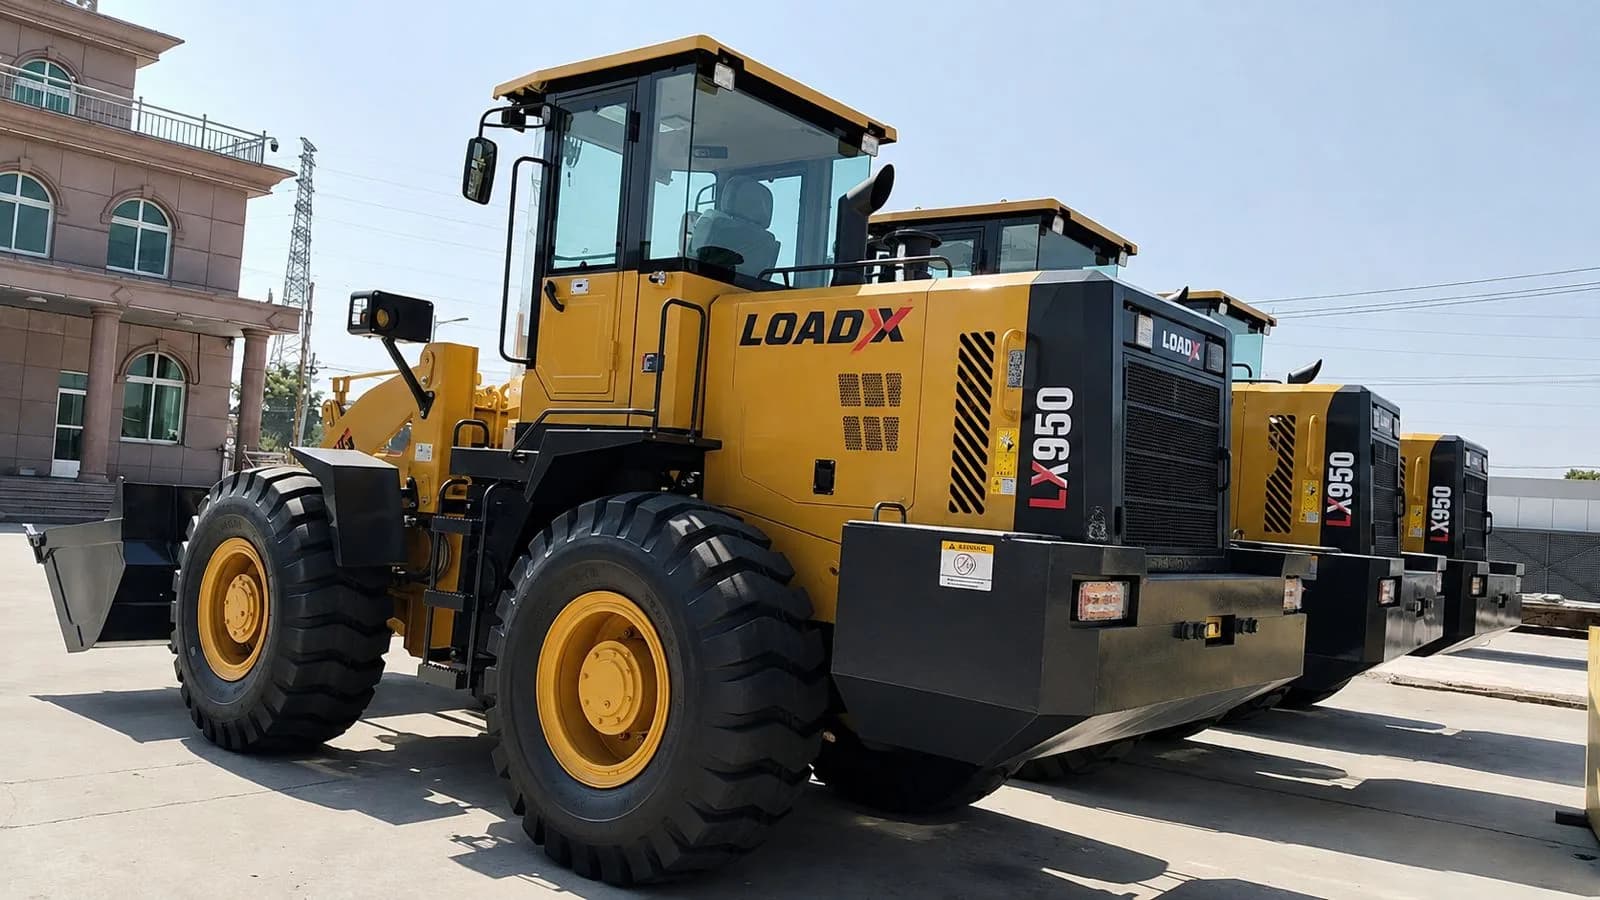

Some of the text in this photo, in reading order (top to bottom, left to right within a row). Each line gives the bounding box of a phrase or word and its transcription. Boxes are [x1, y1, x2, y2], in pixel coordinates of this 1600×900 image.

[739, 307, 914, 351] LOADX
[1162, 330, 1200, 362] LOADX
[1029, 387, 1074, 509] LX950
[1326, 451, 1355, 527] LX950
[1430, 486, 1451, 542] LX950
